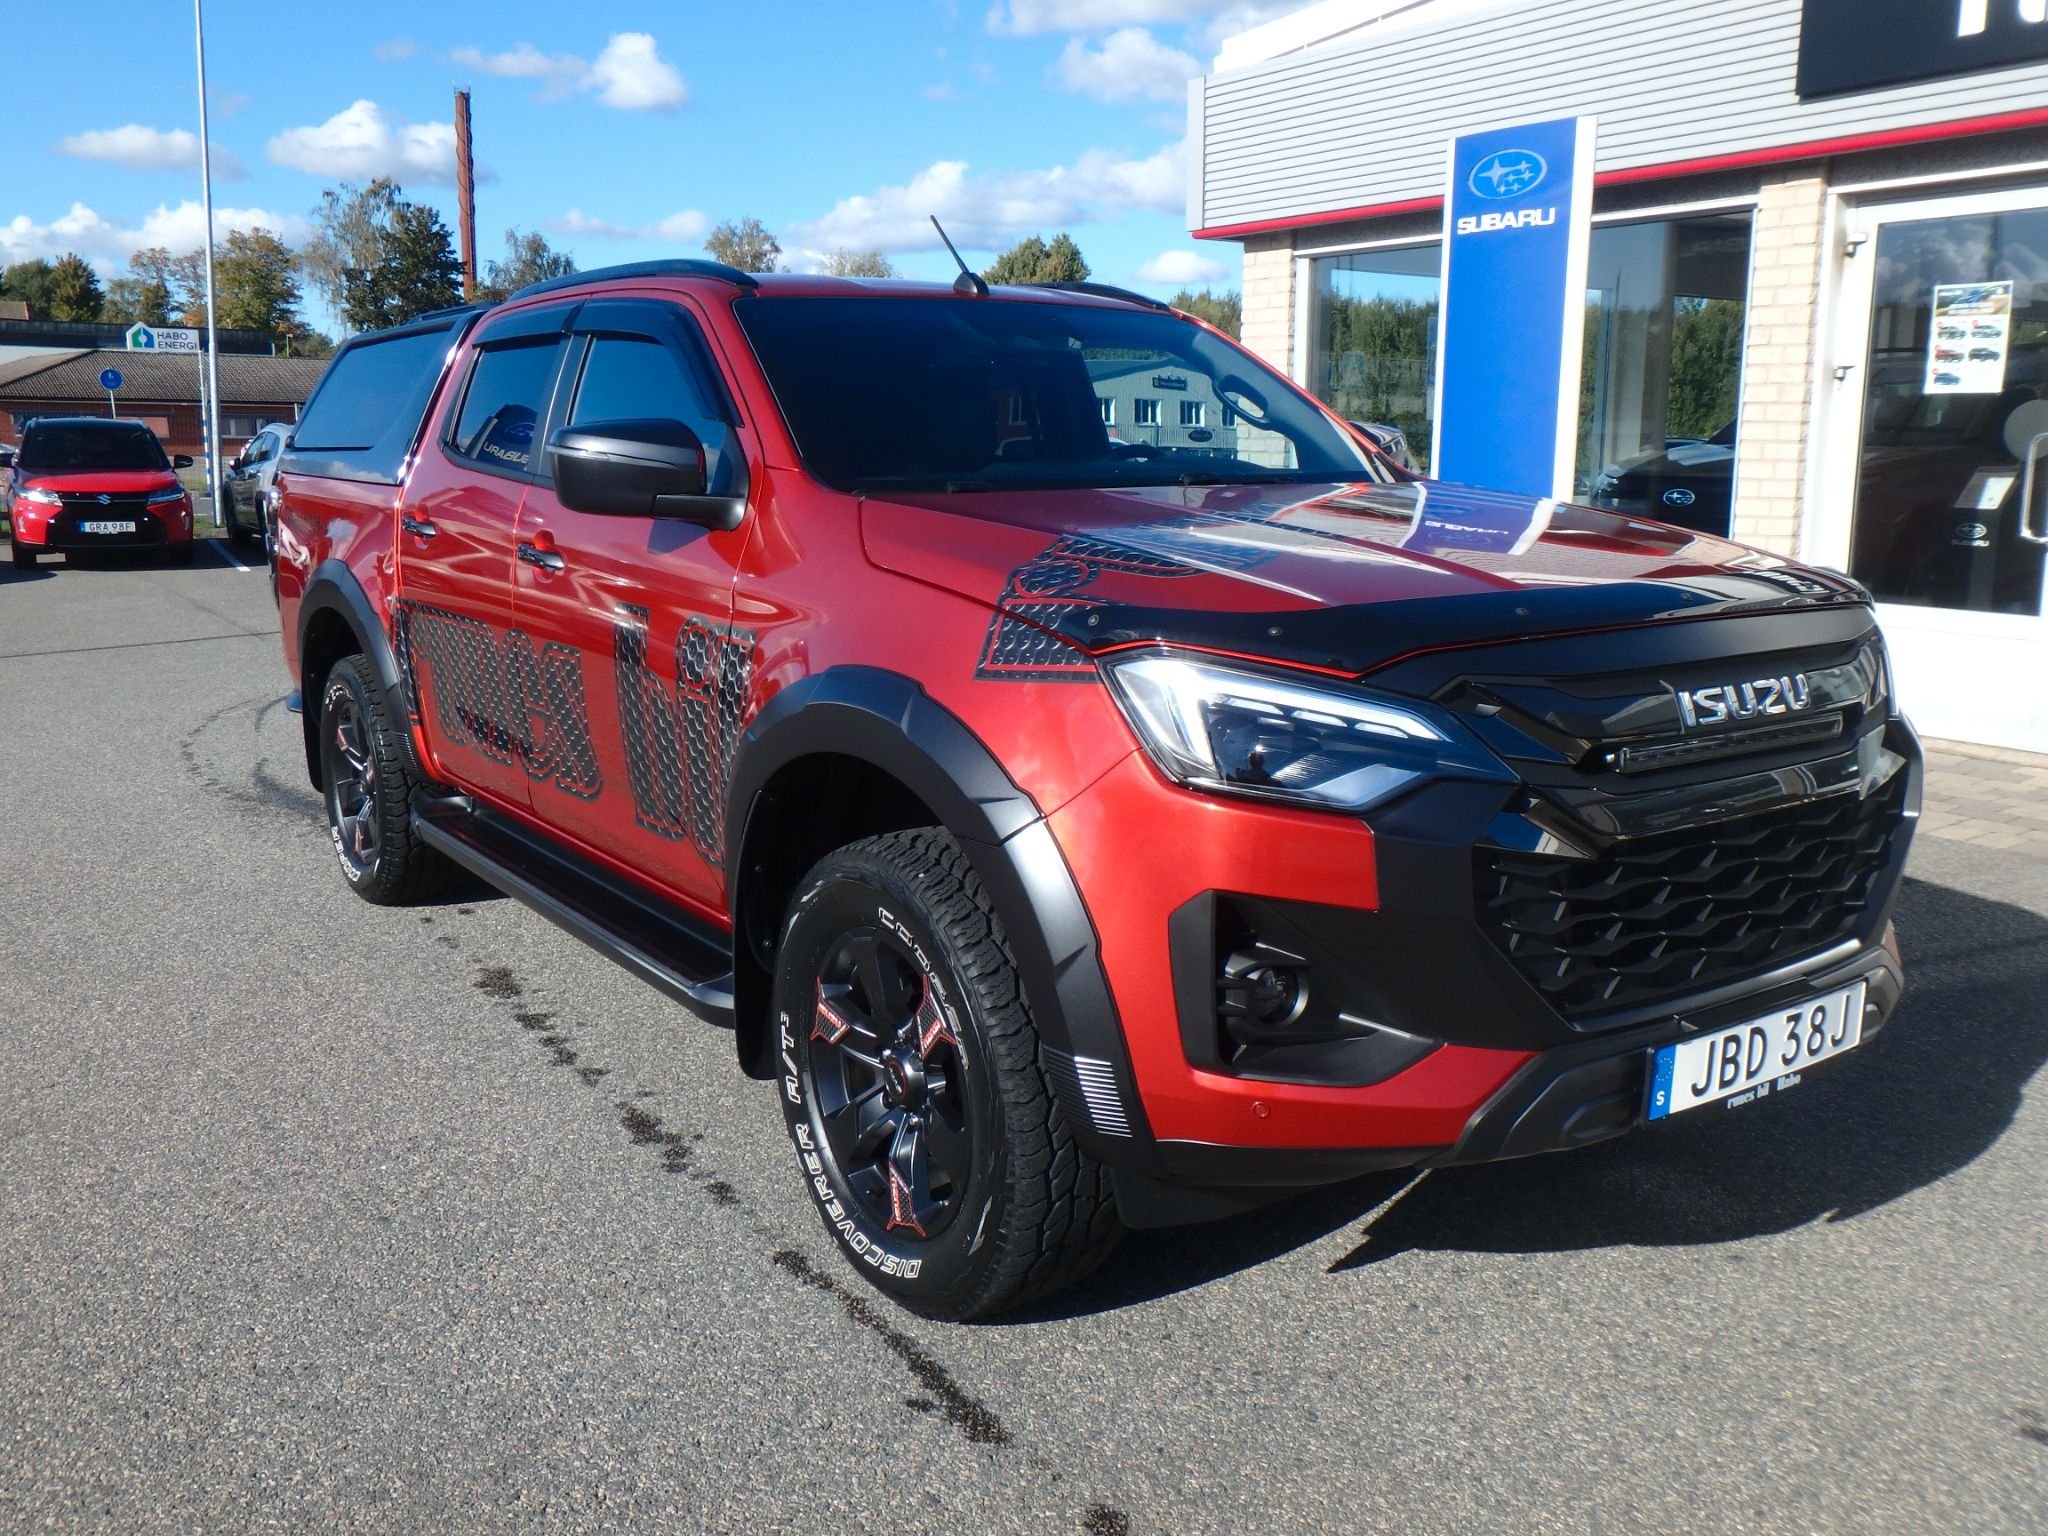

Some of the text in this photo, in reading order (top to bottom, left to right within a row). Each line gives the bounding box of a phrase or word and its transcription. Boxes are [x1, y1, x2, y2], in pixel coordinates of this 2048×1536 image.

[1457, 208, 1556, 235] SUBARU
[157, 332, 188, 340] HABO
[158, 341, 197, 350] ENERGI
[89, 522, 131, 531] GRA 98F
[1678, 673, 1812, 727] ISUZU
[878, 907, 970, 1070] COOPER
[1691, 994, 1850, 1098] JBD 38J
[1656, 1091, 1665, 1106] S
[795, 1123, 922, 1279] DISCOVERER
